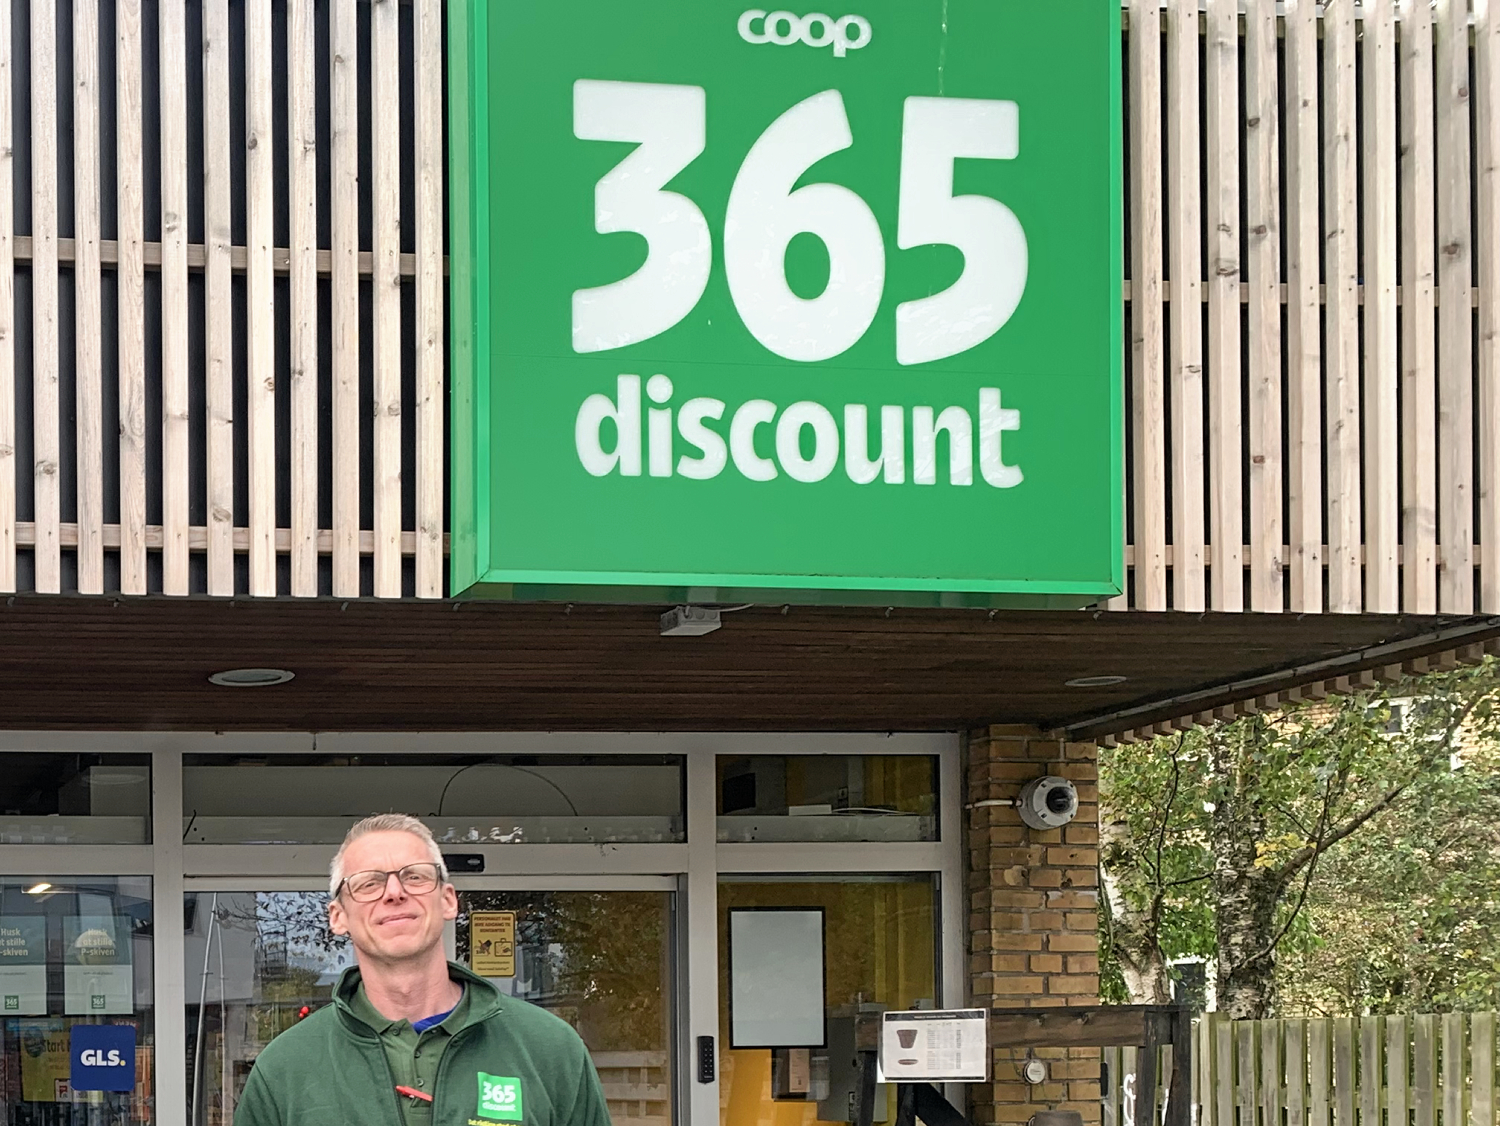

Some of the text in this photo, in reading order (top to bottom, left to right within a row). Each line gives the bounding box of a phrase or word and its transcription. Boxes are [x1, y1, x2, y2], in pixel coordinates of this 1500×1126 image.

[737, 9, 872, 57] coop
[572, 78, 1029, 365] 365
[575, 374, 1024, 488] discount
[0, 928, 21, 936] Husk
[6, 938, 26, 946] stille
[81, 949, 115, 957] P-skiven
[80, 1049, 126, 1067] GLS.
[482, 1081, 517, 1104] 365
